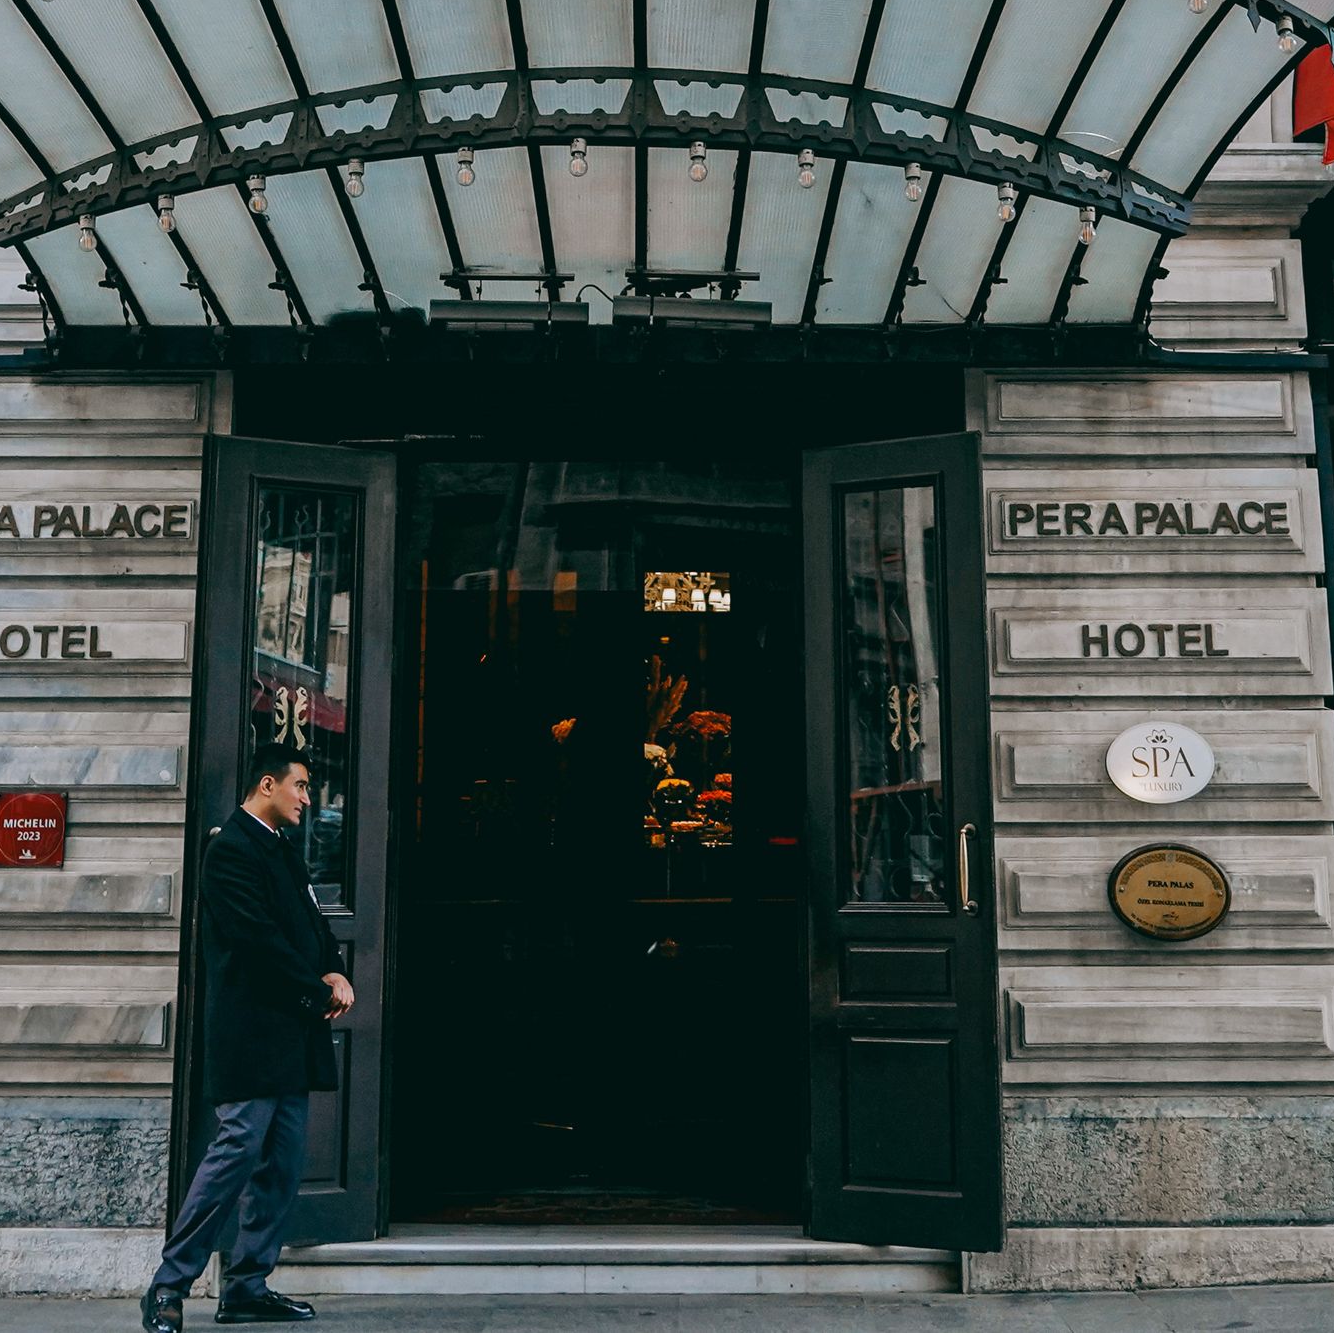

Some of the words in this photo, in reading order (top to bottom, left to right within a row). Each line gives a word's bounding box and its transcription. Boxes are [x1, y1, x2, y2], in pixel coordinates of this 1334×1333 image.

[33, 504, 188, 538] PALACE
[1009, 503, 1128, 536] PERA
[1135, 501, 1291, 535] PALACE
[1082, 623, 1229, 657] HOTEL
[1131, 746, 1196, 778] SPA
[3, 818, 57, 828] MICHELIN
[16, 831, 41, 841] 2023
[1147, 880, 1168, 888] PERA
[1170, 880, 1195, 889] PALAS
